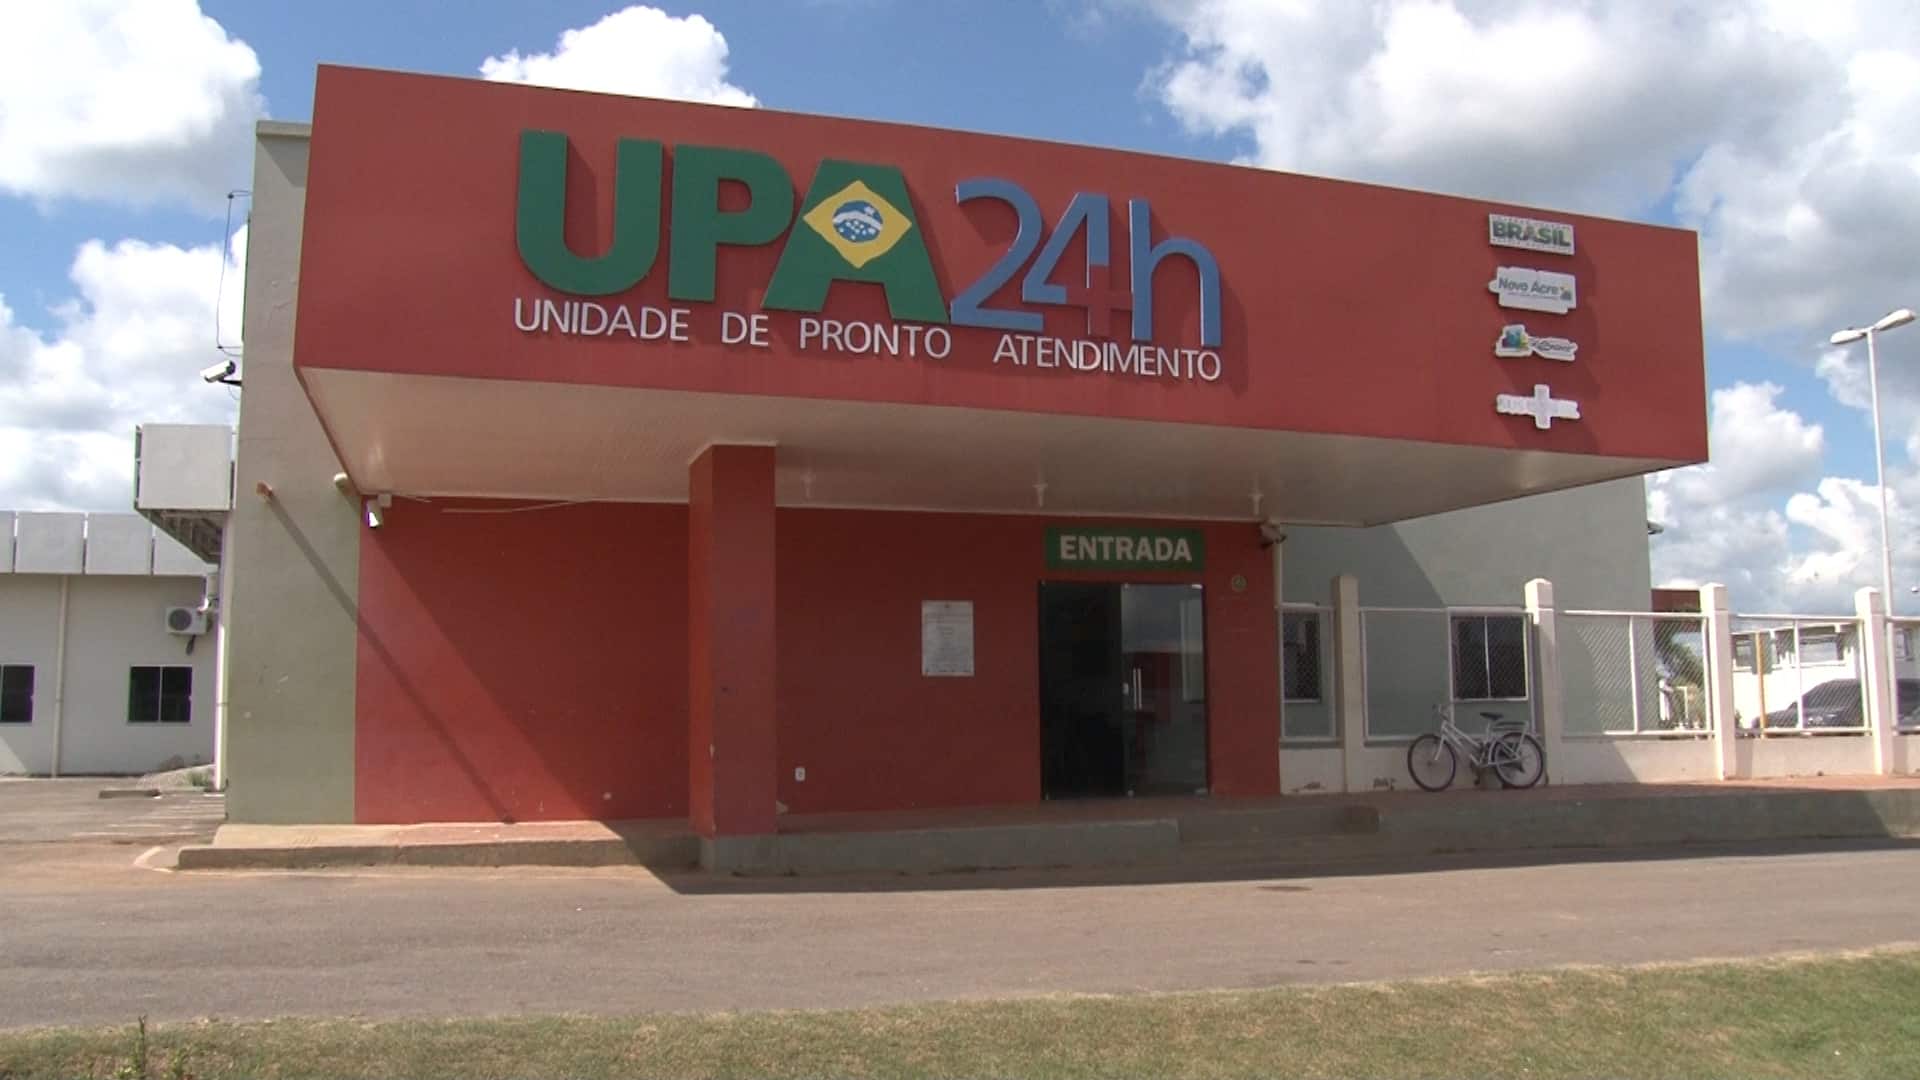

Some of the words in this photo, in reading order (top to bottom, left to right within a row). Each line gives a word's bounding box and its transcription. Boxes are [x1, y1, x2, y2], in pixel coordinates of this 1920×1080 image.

[515, 128, 950, 325] UPA
[950, 176, 1222, 348] 24h
[1492, 220, 1572, 248] BRASIL
[1498, 277, 1529, 292] Novo
[1530, 280, 1560, 295] Acre
[514, 297, 691, 342] UNIDADE
[721, 311, 769, 347] DE
[799, 317, 952, 360] PRONTO
[993, 333, 1222, 382] ATENDIMENTO
[1060, 535, 1193, 562] ENTRADA
